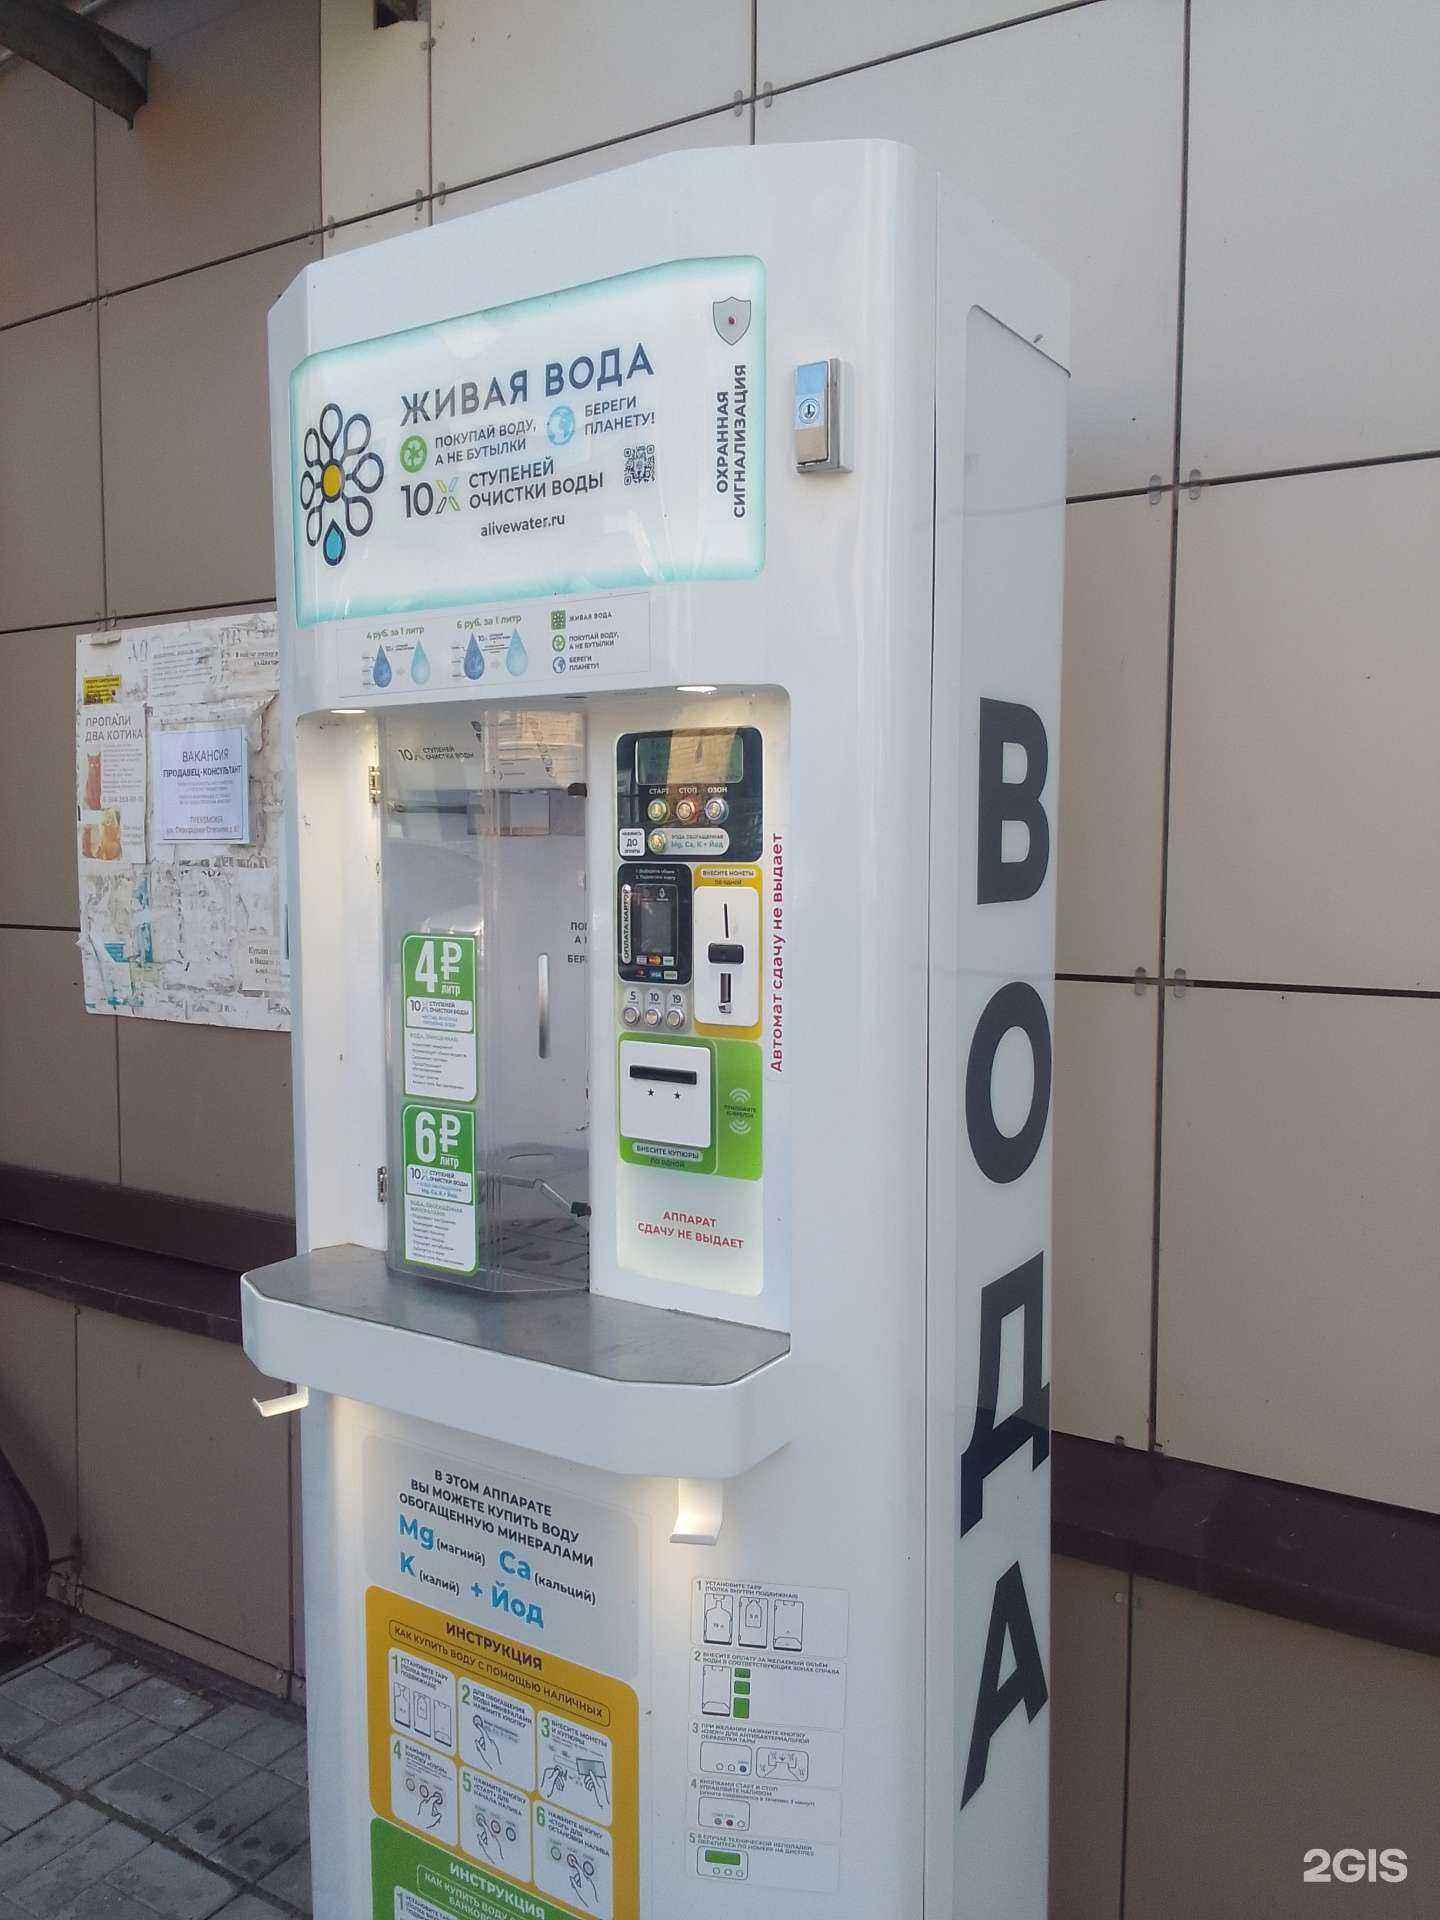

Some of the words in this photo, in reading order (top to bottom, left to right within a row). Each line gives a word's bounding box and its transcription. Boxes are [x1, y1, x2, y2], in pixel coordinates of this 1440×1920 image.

[400, 370, 528, 427] ЖИВАЯ
[545, 342, 654, 397] ВОДА
[584, 396, 637, 417] БЕРЕГИ
[435, 424, 495, 448] ПОКУПАЙ
[499, 419, 537, 438] ВОДУ,
[584, 411, 655, 436] ПЛАНЕТУ!
[435, 455, 444, 465] А
[447, 451, 464, 464] НЕ
[466, 438, 526, 460] БУТЫЛКИ
[716, 391, 729, 493] ОХРАННАЯ
[733, 365, 748, 518] СИГНАЛИЗАЦИЯ
[469, 457, 554, 488] СТУПЕНЕЙ
[469, 483, 546, 509] ОЧИСТКИ
[551, 472, 604, 496] ВОДЫ
[480, 513, 566, 537] alivewater.ru
[456, 619, 463, 630] 6
[86, 715, 131, 727] ПРОПАЛИ
[85, 730, 105, 742] ДВА
[107, 729, 144, 742] КОТИКА
[182, 748, 229, 762] ВАКАНСИЯ
[626, 839, 638, 848] ДО
[772, 833, 783, 903] выдает
[772, 907, 783, 930] не
[623, 924, 631, 959] ОПЛАТА
[773, 934, 786, 990] сдачу
[629, 991, 636, 1000] 5
[649, 992, 659, 1001] 10
[672, 994, 681, 1003] 19
[770, 994, 783, 1072] Автомат
[440, 1156, 460, 1169] литр
[636, 1145, 667, 1155] ВНЕСИТЕ
[667, 1148, 699, 1159] КУПЮРЫ
[663, 1211, 718, 1228] АППАРАТ
[638, 1222, 674, 1236] СДАЧУ
[677, 1230, 692, 1240] НЕ
[695, 1232, 744, 1248] ВЫДАЕТ
[959, 697, 1052, 1812] ВОДА
[435, 1470, 443, 1481] В
[446, 1474, 479, 1492] ЭТОМ
[483, 1486, 552, 1517] АППАРАТЕ
[411, 1479, 429, 1494] ВЫ
[432, 1486, 485, 1513] МОЖЕТЕ
[488, 1505, 539, 1530] КУПИТЬ
[542, 1522, 579, 1543] ВОДУ
[399, 1492, 495, 1534] ОБОГАЩЕННУЮ
[498, 1525, 594, 1567] МИНЕРАЛАМИ
[399, 1514, 434, 1550] Mg
[437, 1538, 486, 1567] (магний)
[499, 1550, 531, 1580] Ca
[534, 1572, 596, 1606] (кальций)
[697, 1580, 702, 1591] 1
[419, 1570, 460, 1597] (калий)
[470, 1582, 484, 1597] +
[491, 1580, 544, 1629] Йод
[446, 1621, 542, 1671] ИНСТРУКЦИЯ
[694, 1651, 701, 1661] 2
[392, 1654, 399, 1674] 1
[394, 1626, 412, 1641] КАК
[413, 1633, 449, 1656] КУПИТЬ
[450, 1648, 476, 1666] ВОДУ
[478, 1661, 485, 1671] С
[486, 1663, 541, 1693] ПОМОЩЬЮ
[544, 1685, 604, 1718] НАЛИЧНЫХ
[462, 1684, 470, 1705] 2
[541, 1716, 550, 1738] 3
[692, 1722, 699, 1733] 3
[393, 1741, 401, 1759] 4
[462, 1772, 471, 1792] 5
[690, 1778, 697, 1789] 4
[536, 1806, 546, 1827] 6
[689, 1832, 695, 1843] 5
[424, 1872, 442, 1888] КАК
[444, 1883, 480, 1908] КУПИТЬ
[481, 1902, 508, 1920] ВОДУ
[450, 1861, 545, 1920] ИНСТРУКЦИЯ
